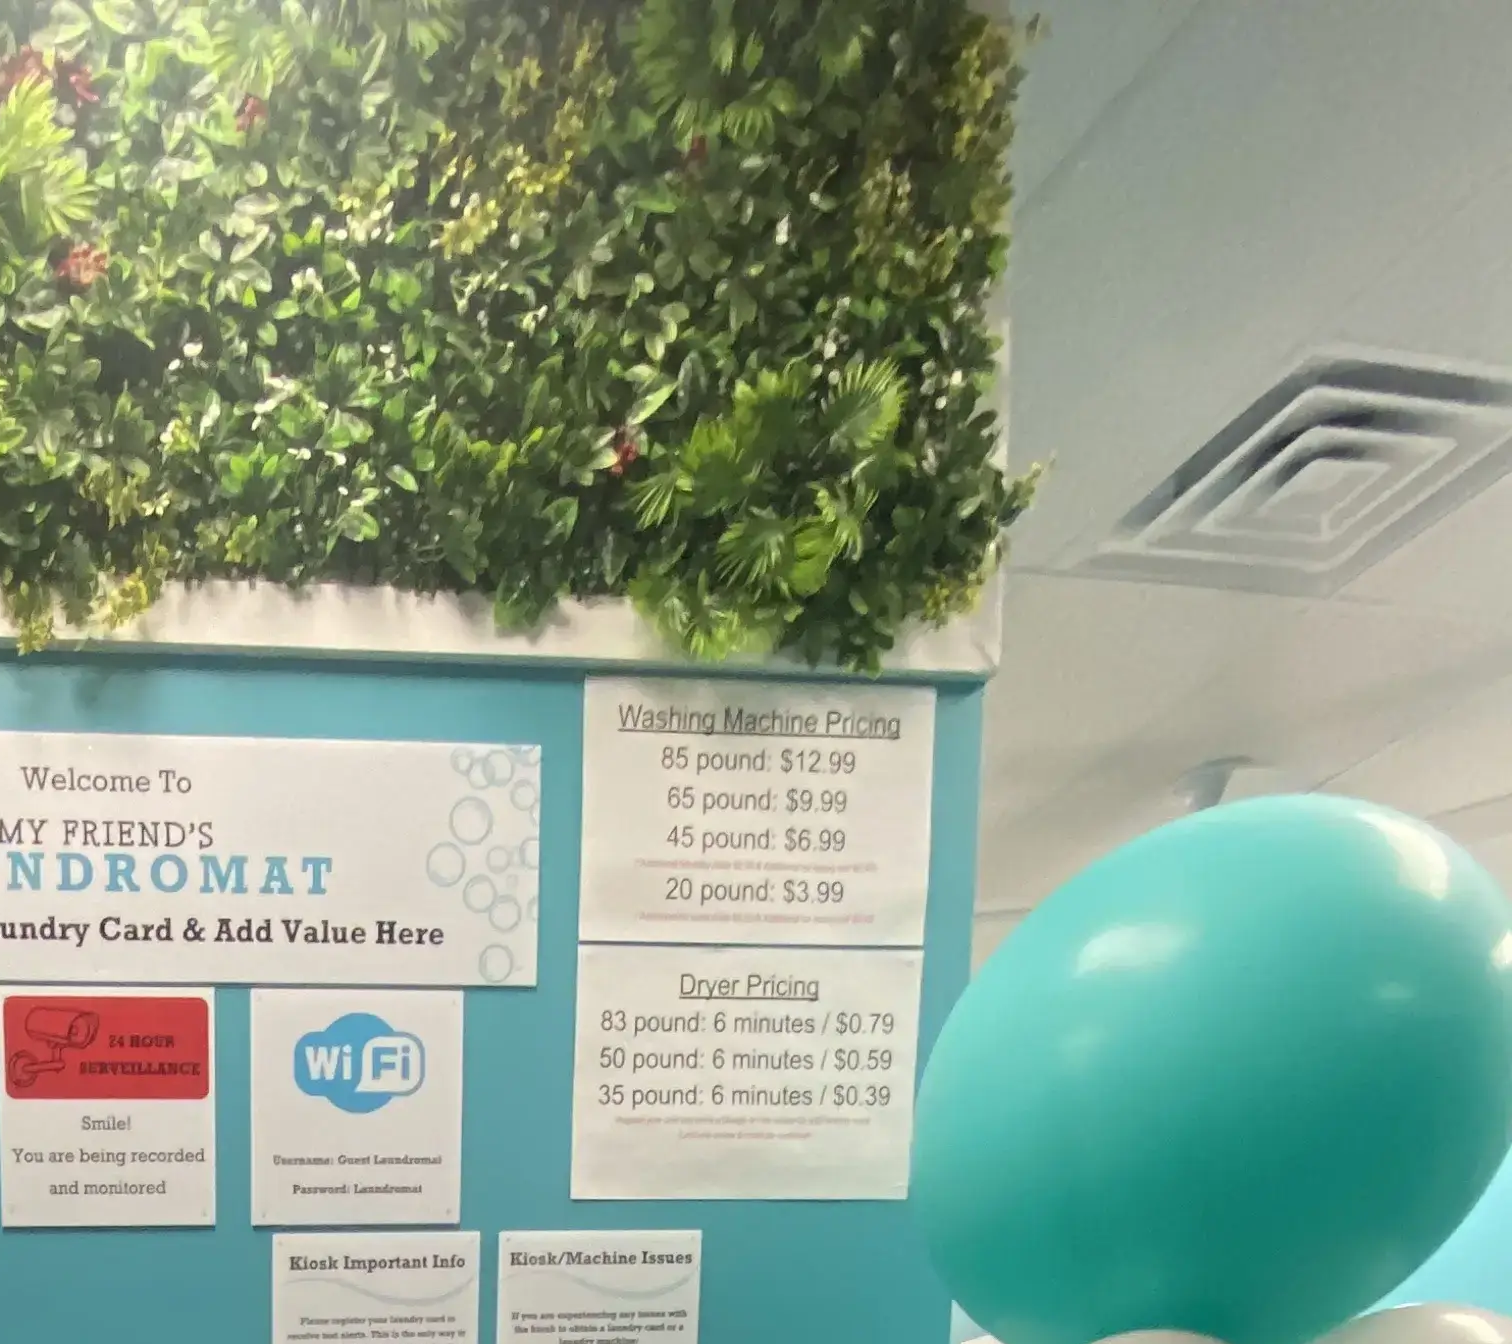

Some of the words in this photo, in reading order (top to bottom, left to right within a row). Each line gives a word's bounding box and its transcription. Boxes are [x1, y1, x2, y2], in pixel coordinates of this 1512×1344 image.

[619, 704, 715, 735] Washing
[724, 706, 818, 734] Machine
[826, 711, 900, 740] Pricing
[662, 747, 688, 769] 85
[697, 749, 771, 774] pound:
[781, 749, 856, 774] $12.99
[21, 766, 150, 793] Welcome
[159, 770, 192, 793] To
[668, 787, 694, 809] 65
[703, 788, 777, 814] pound:
[786, 788, 847, 812] $9.99
[63, 819, 213, 849] FRIEND'S
[667, 826, 694, 847] 45
[702, 828, 775, 852] pound:
[784, 828, 846, 852] $6.99
[666, 878, 692, 900] 20
[701, 879, 775, 906] pound:
[783, 880, 844, 903] $3.99
[99, 916, 173, 942] Card
[183, 918, 205, 942] &
[214, 919, 272, 943] Add
[281, 920, 366, 944] Value
[375, 921, 443, 945] Here
[681, 974, 739, 1000] Dryer
[747, 975, 819, 1001] Pricing
[601, 1010, 626, 1031] 83
[635, 1012, 705, 1036] pound:
[714, 1012, 725, 1032] 6
[734, 1013, 814, 1033] minutes
[837, 1012, 894, 1034] $0.79
[109, 1035, 124, 1047] 24
[130, 1035, 174, 1047] HOUR
[600, 1048, 625, 1068] 50
[633, 1049, 704, 1073] pound:
[712, 1049, 724, 1069] 6
[733, 1050, 813, 1069] minutes
[835, 1049, 892, 1070] $0.59
[599, 1085, 624, 1105] 35
[632, 1086, 703, 1109] pound:
[712, 1086, 724, 1105] 6
[732, 1086, 812, 1106] minutes
[834, 1085, 890, 1107] $0.39
[82, 1115, 131, 1131] Smile!
[13, 1149, 44, 1163] You
[49, 1152, 74, 1163] are
[80, 1149, 125, 1166] being
[131, 1149, 205, 1163] recorded
[273, 1155, 333, 1166] Username:
[338, 1154, 370, 1165] Guest
[374, 1154, 441, 1165] Laundromat
[49, 1181, 79, 1195] and
[84, 1181, 166, 1195] monitored
[293, 1184, 350, 1194] Password:
[354, 1184, 422, 1194] Laundromat
[289, 1256, 338, 1271] Kiosk
[343, 1256, 427, 1273] Important
[433, 1255, 465, 1269] Info
[510, 1252, 637, 1266] Kiosk/Machine
[642, 1251, 692, 1265] Issues
